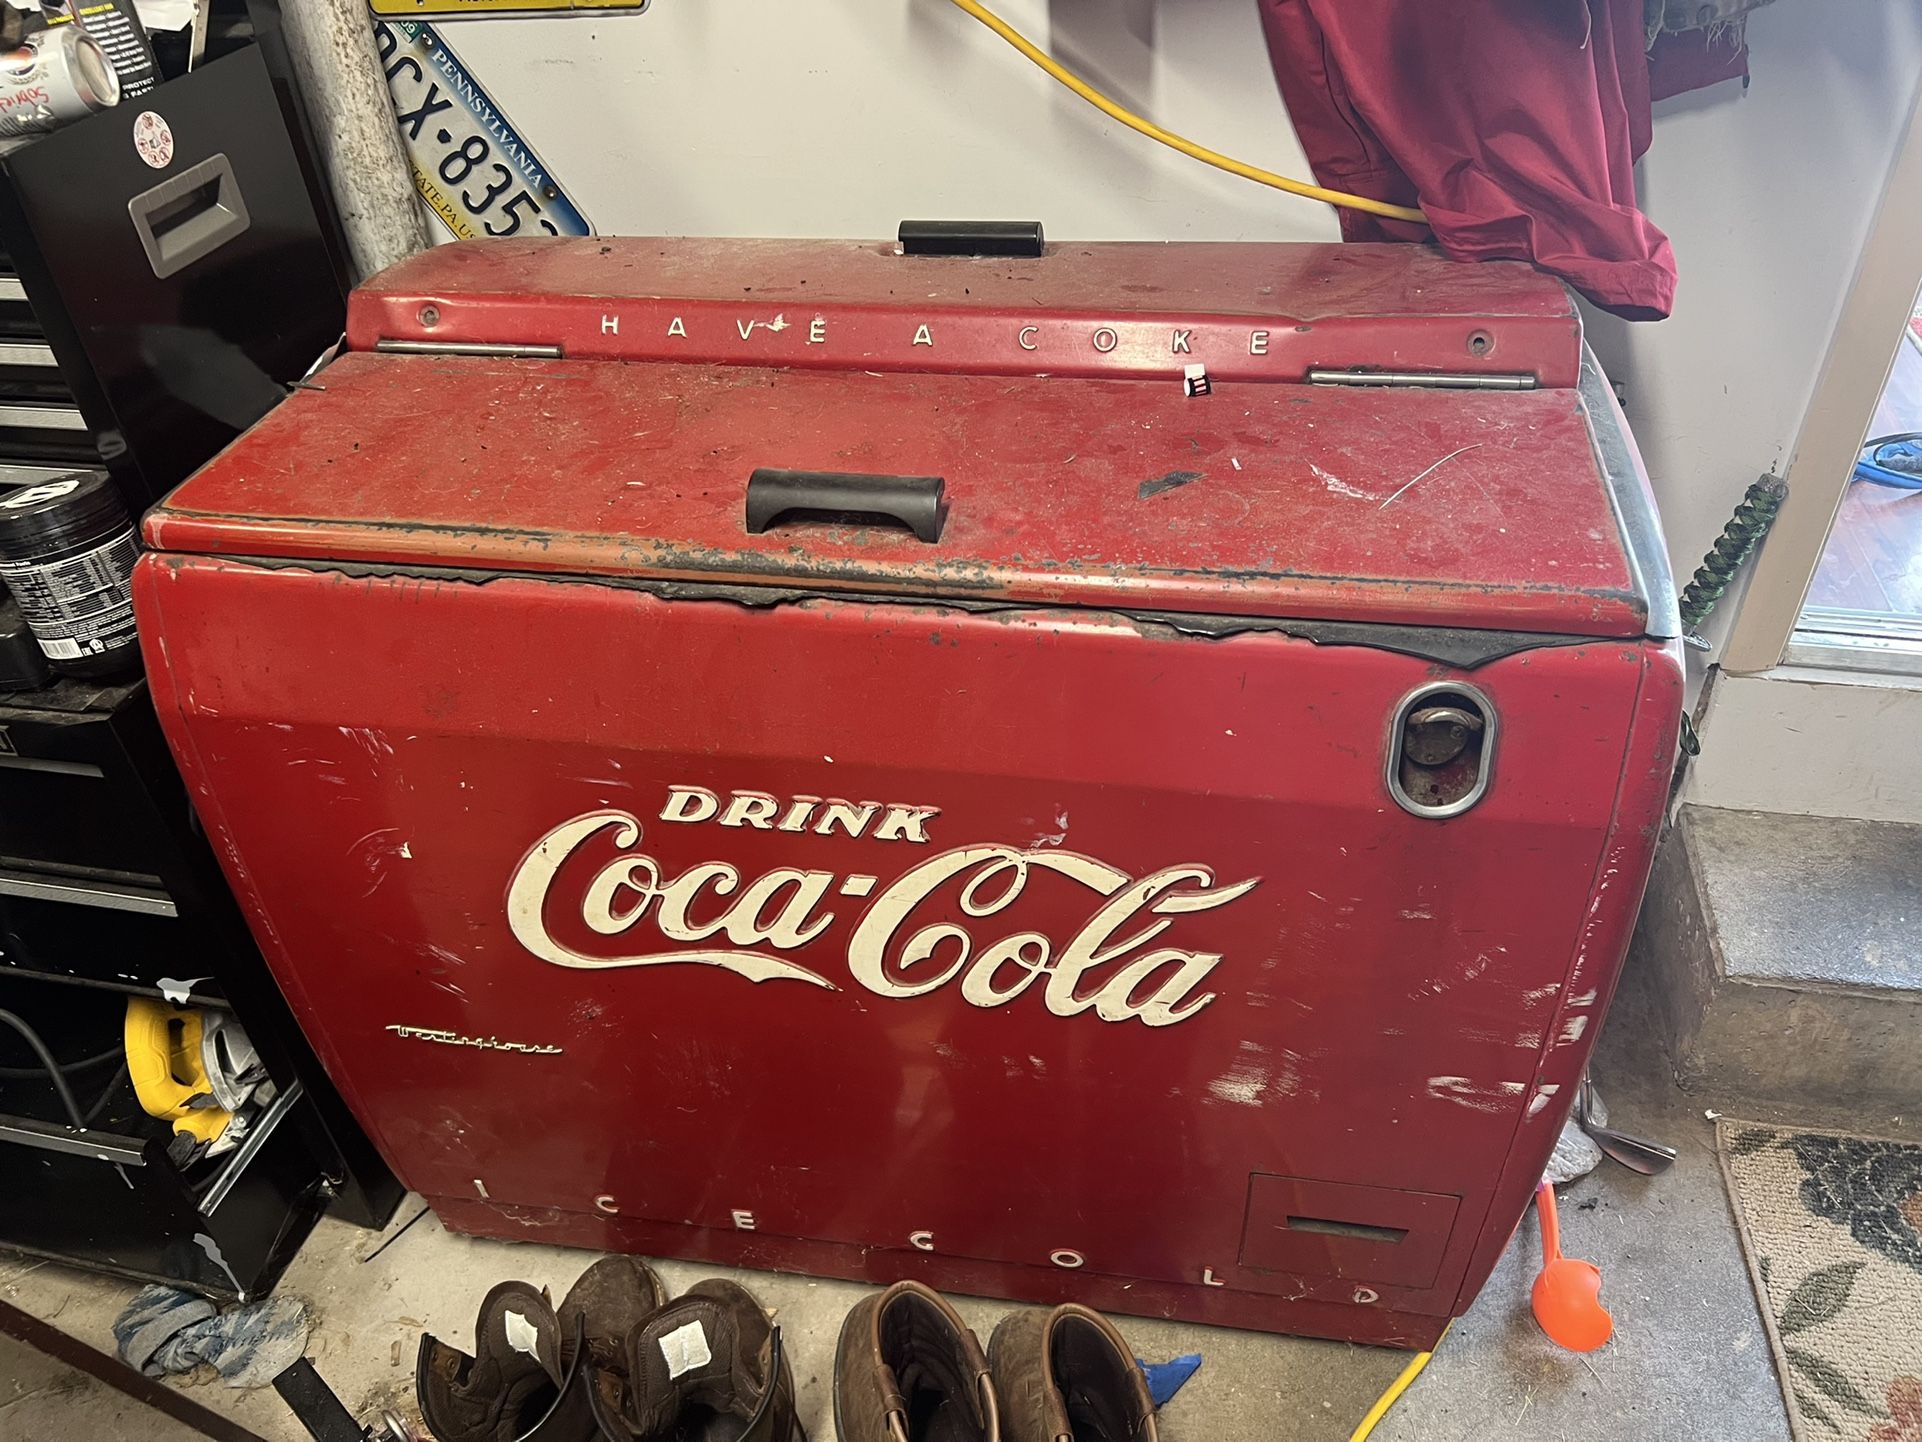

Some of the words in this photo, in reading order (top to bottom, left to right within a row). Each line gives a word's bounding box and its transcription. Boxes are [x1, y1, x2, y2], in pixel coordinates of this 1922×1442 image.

[431, 48, 545, 188] PENNSYLVANIA
[600, 315, 827, 345] HAVE
[912, 323, 934, 348] A
[1017, 324, 1271, 357] COKE
[659, 784, 942, 844] DRINK
[505, 808, 1264, 1029] Coca-Cola
[473, 1178, 757, 1232] ICE
[909, 1229, 1382, 1305] COLD
